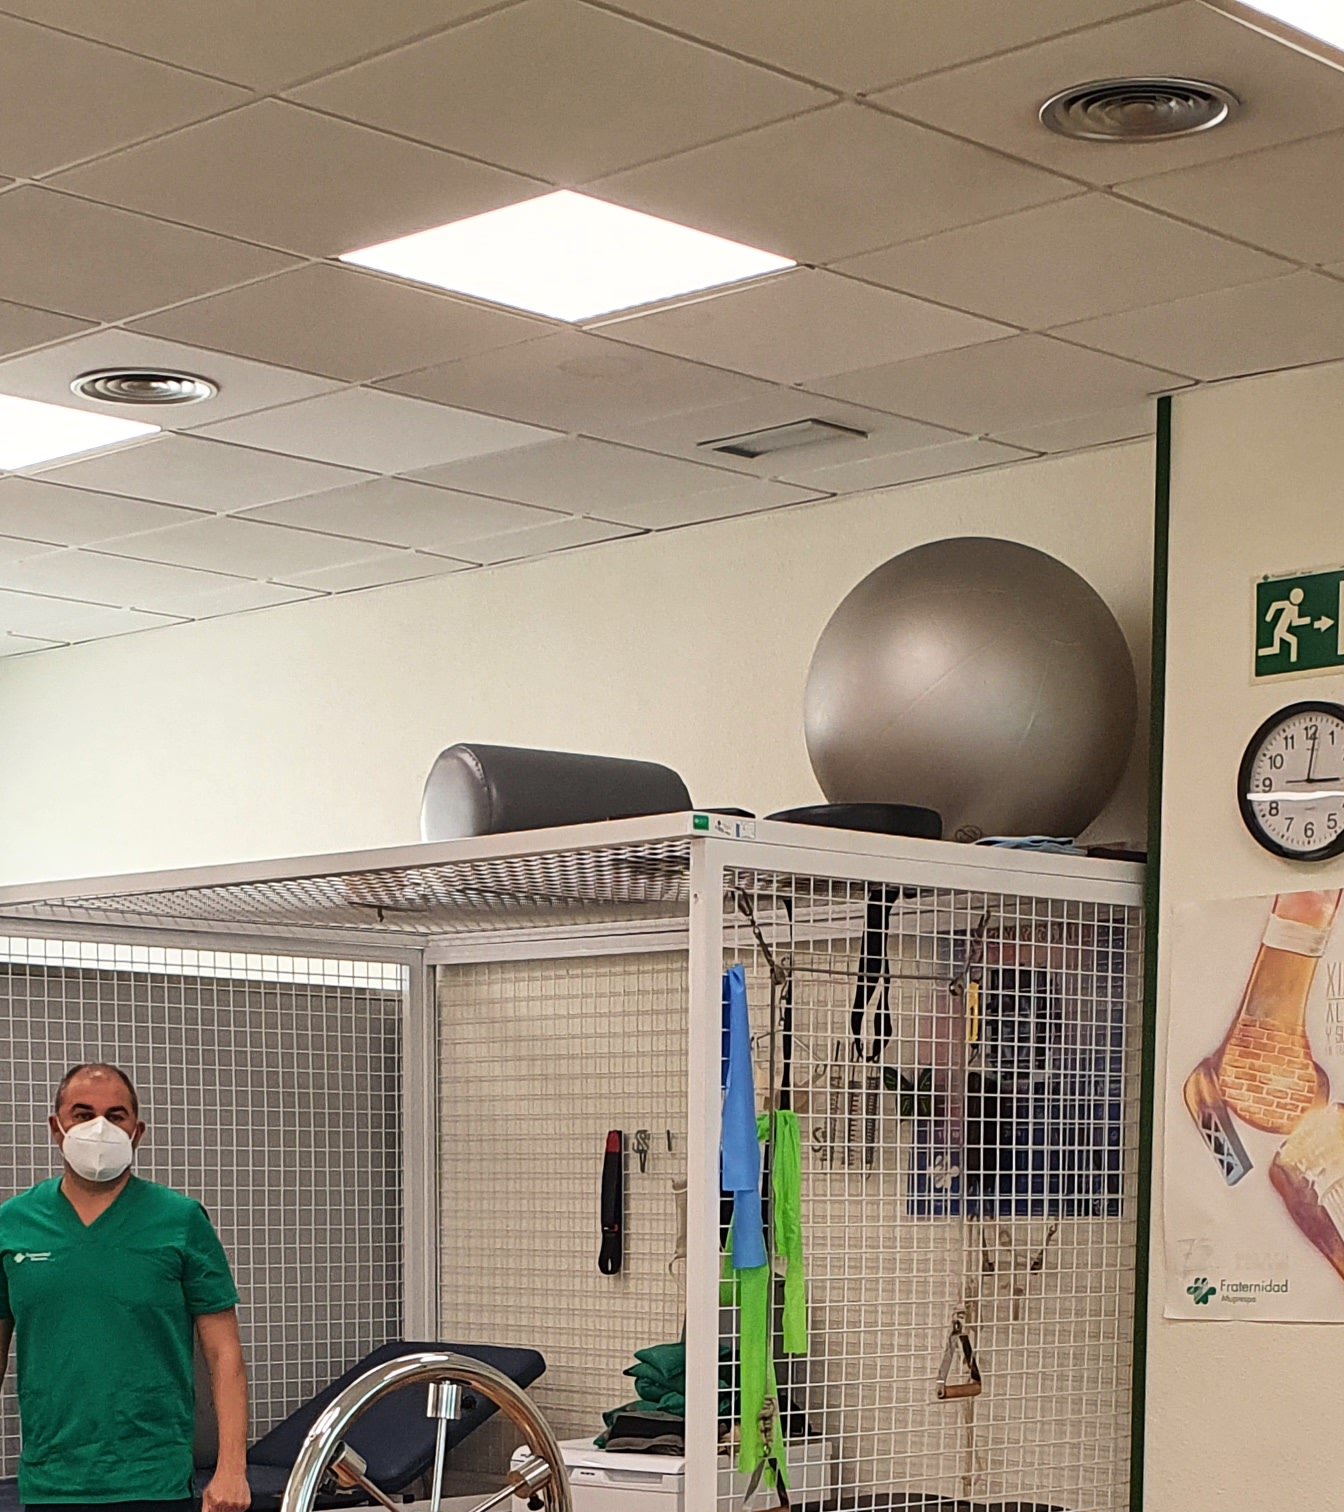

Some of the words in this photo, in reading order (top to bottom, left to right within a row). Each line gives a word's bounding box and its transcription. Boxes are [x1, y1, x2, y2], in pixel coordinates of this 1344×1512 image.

[1304, 724, 1319, 741] 12
[1329, 730, 1335, 745] 1
[1283, 734, 1295, 750] 11
[1268, 753, 1284, 770] 10
[1262, 777, 1273, 793] 9
[1268, 800, 1279, 817] 8
[1284, 817, 1294, 833] 7
[1327, 813, 1338, 830] 5
[1304, 822, 1315, 839] 6
[1220, 1279, 1289, 1294] Fraternidad
